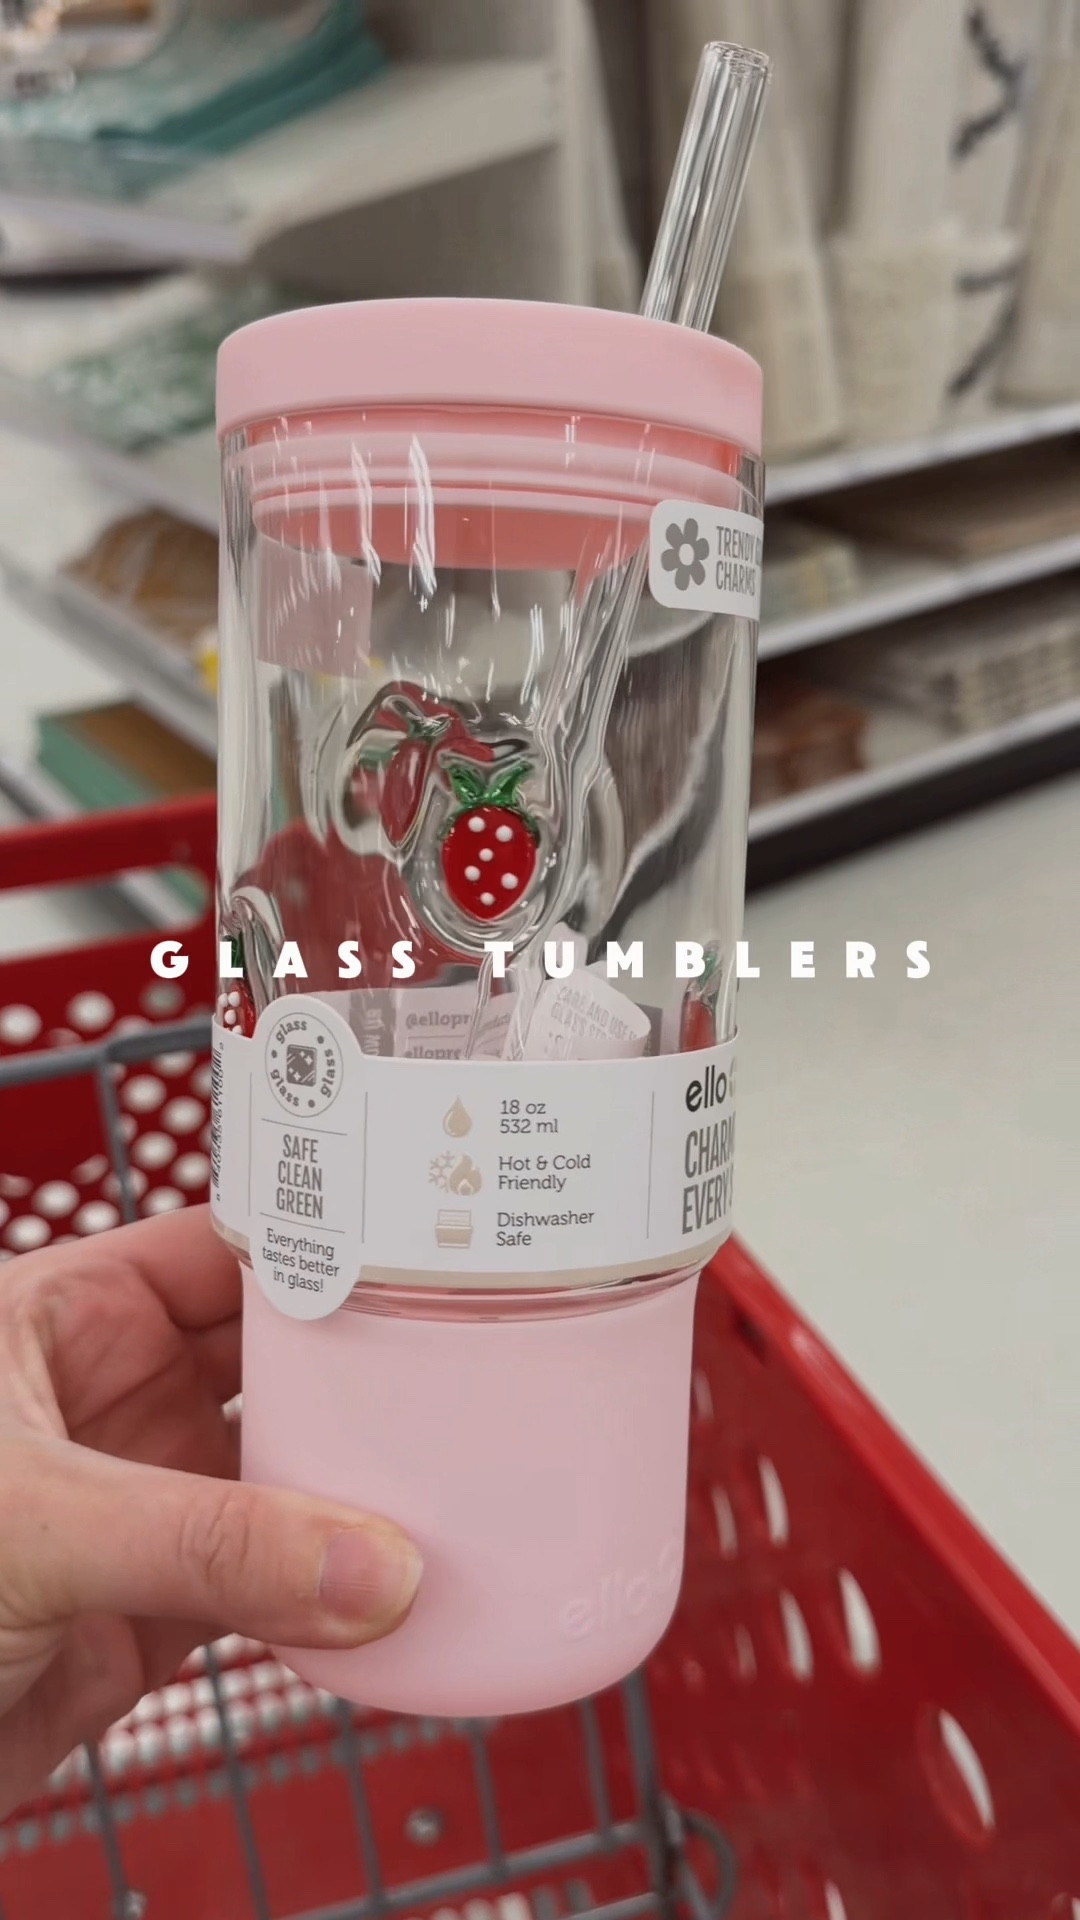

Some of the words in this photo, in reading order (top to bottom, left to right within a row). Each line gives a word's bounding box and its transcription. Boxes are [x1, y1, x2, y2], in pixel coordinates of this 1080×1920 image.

[715, 559, 756, 597] CHARMS
[275, 1020, 308, 1045] glass
[405, 1011, 473, 1030] @ellopr
[320, 1048, 336, 1098] glass
[269, 1068, 300, 1108] glass
[685, 1064, 728, 1113] ello
[500, 1099, 520, 1115] 18
[525, 1102, 547, 1115] oz
[499, 1118, 532, 1134] 532
[536, 1118, 559, 1134] ml
[282, 1133, 319, 1164] SAFE
[498, 1155, 532, 1171] Hot
[536, 1155, 549, 1171] &
[553, 1153, 592, 1171] Cold
[277, 1160, 323, 1192] CLEAN
[498, 1174, 568, 1193] Friendly
[276, 1187, 324, 1220] GREEN
[496, 1210, 595, 1228] Dishwasher
[266, 1227, 335, 1261] Everything
[496, 1231, 532, 1247] Safe
[262, 1246, 297, 1268] tastes
[299, 1254, 341, 1278] better
[273, 1266, 285, 1284] in
[287, 1272, 324, 1293] glass!
